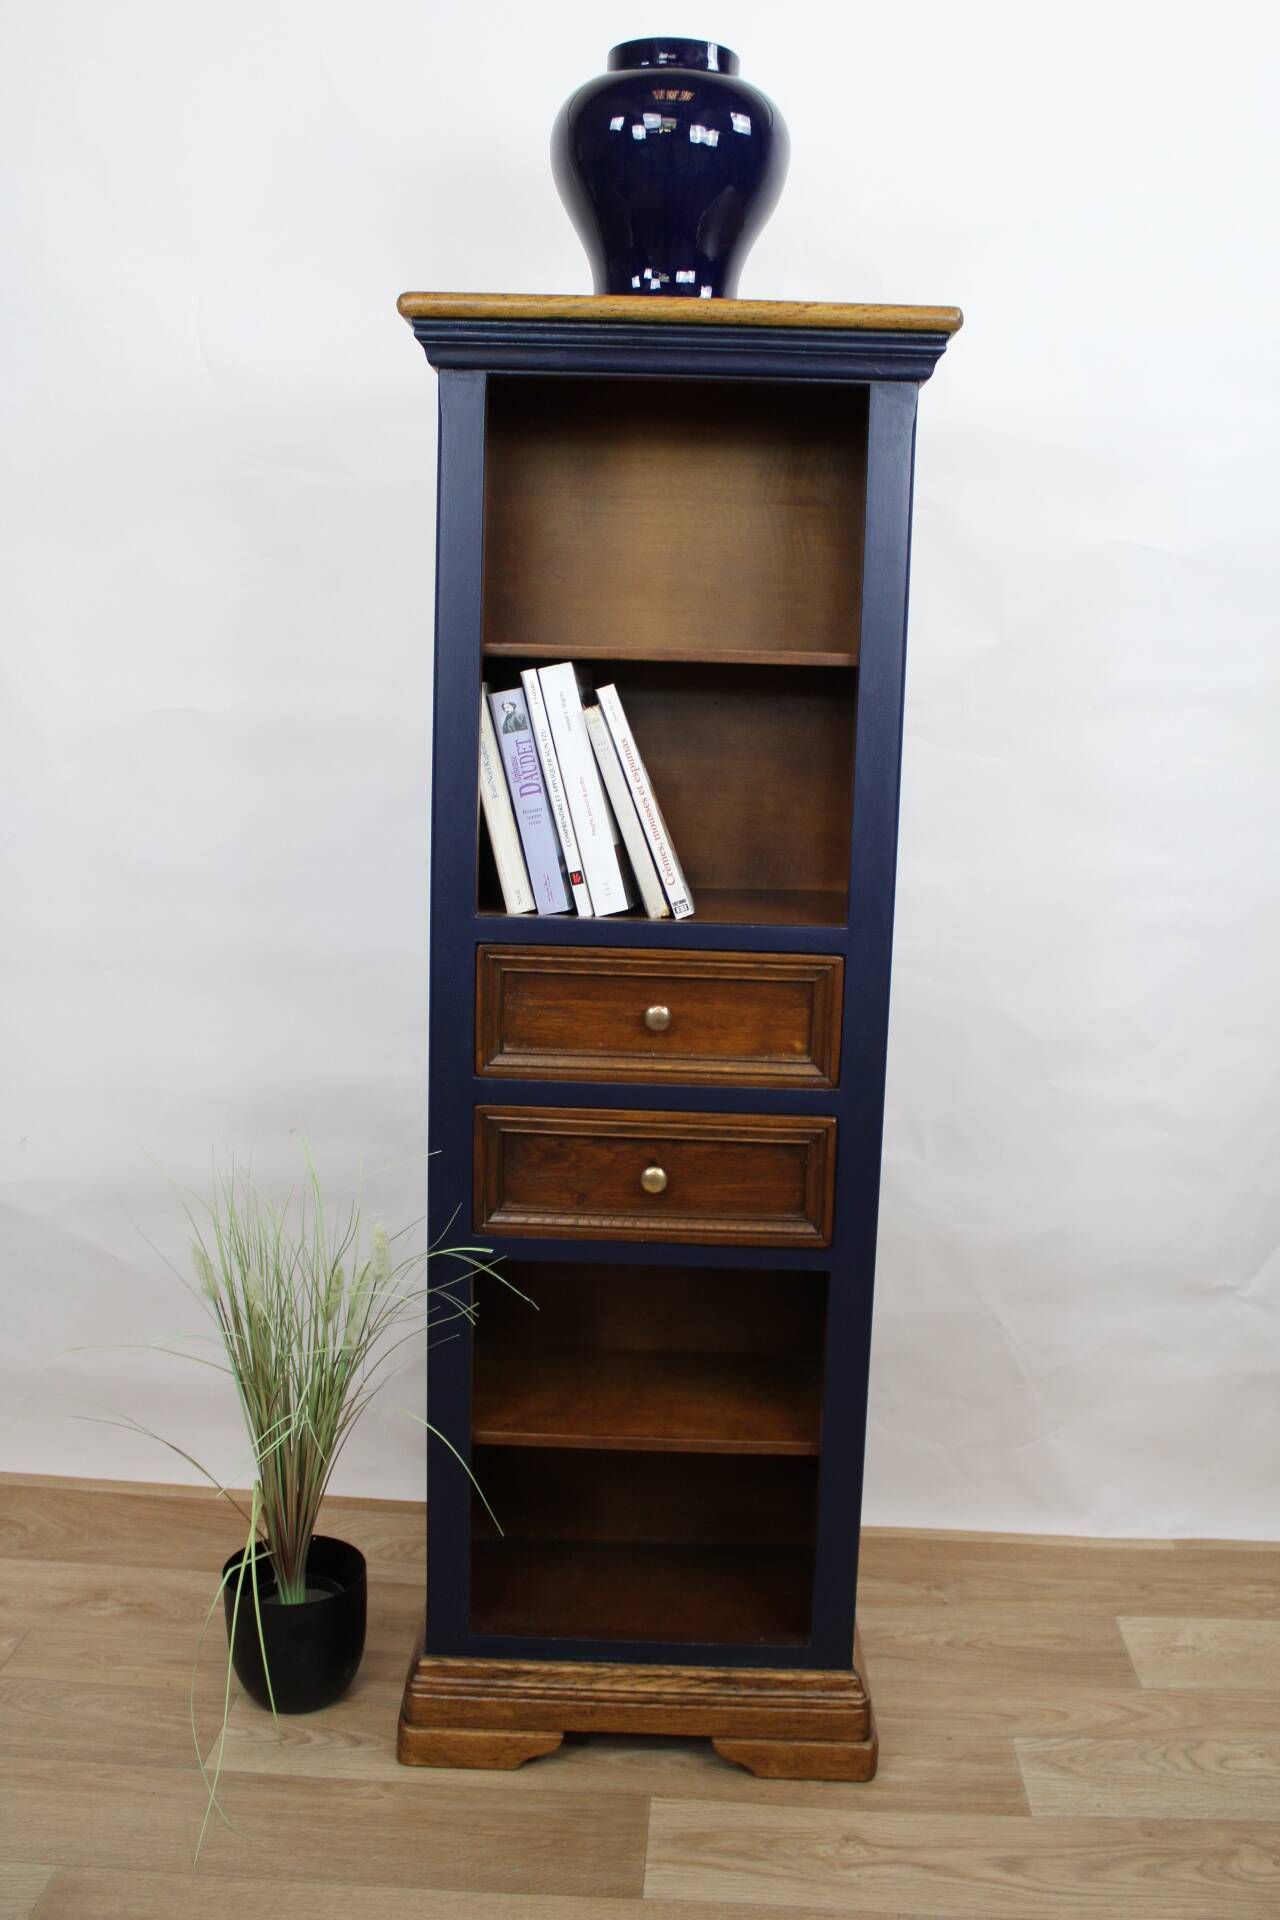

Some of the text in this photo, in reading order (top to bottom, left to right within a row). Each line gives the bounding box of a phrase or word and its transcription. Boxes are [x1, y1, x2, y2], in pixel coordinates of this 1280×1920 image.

[515, 738, 542, 798] DAUDET
[621, 737, 642, 784] espumas
[554, 793, 561, 802] ET
[636, 786, 646, 796] et
[557, 803, 571, 848] COMPRENDRE
[642, 797, 662, 841] mousses
